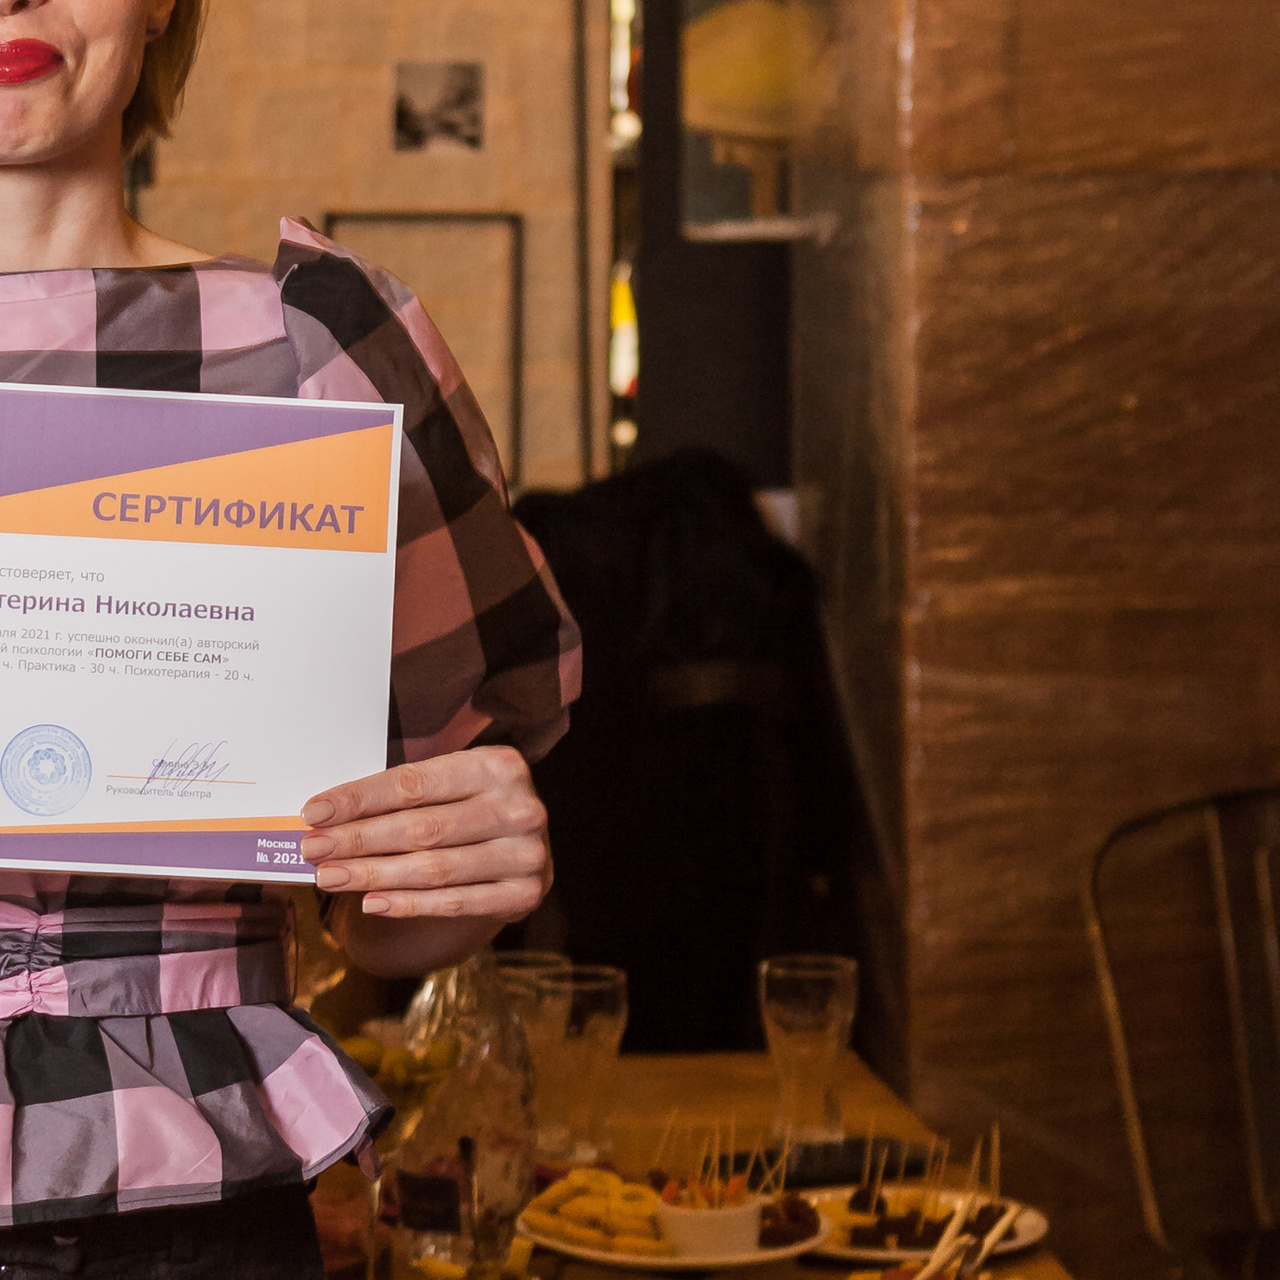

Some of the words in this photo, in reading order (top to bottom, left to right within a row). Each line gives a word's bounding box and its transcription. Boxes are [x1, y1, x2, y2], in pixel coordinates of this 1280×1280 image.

[92, 491, 365, 534] СЕРТИФИКАТ
[80, 571, 105, 583] что
[95, 594, 256, 622] Николаевна
[21, 629, 51, 640] 2021
[55, 631, 63, 641] г.
[67, 632, 121, 644] успешно
[124, 634, 193, 648] окончил(а)
[196, 637, 260, 651] авторский
[12, 644, 83, 658] психологии
[87, 647, 152, 660] «ПОМОГИ
[156, 650, 190, 663] СЕБЕ
[193, 652, 230, 664] САМ»
[2, 660, 14, 670] ч.
[18, 659, 76, 673] Практика
[90, 663, 105, 674] 30
[109, 665, 120, 675] ч.
[124, 664, 211, 680] Психотерапия
[224, 669, 240, 681] 20
[243, 672, 254, 682] ч.
[177, 789, 213, 799] центра
[257, 838, 297, 849] Москва
[273, 852, 306, 865] 2021
